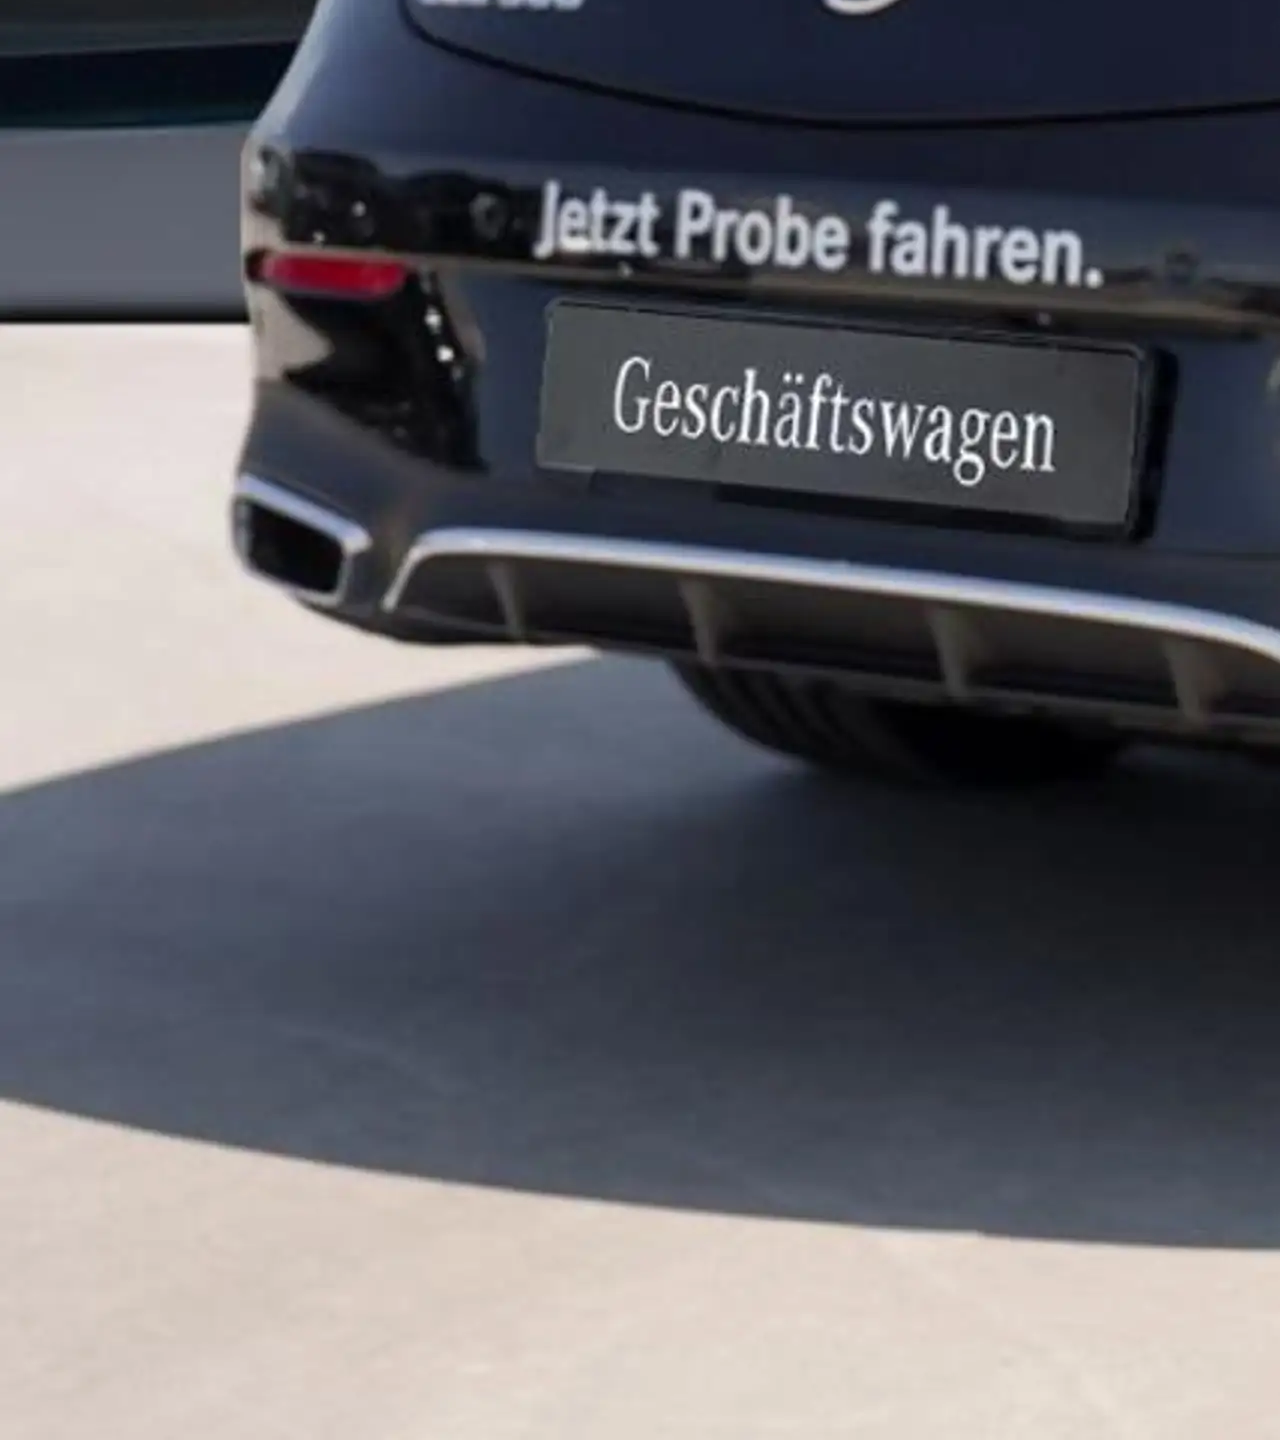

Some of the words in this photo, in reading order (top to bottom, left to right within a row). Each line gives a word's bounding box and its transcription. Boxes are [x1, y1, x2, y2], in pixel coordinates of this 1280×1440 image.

[534, 180, 660, 258] Jetzt
[675, 188, 850, 271] Probe
[867, 200, 1104, 288] fahren.
[612, 354, 1056, 488] Geschäftswagen
